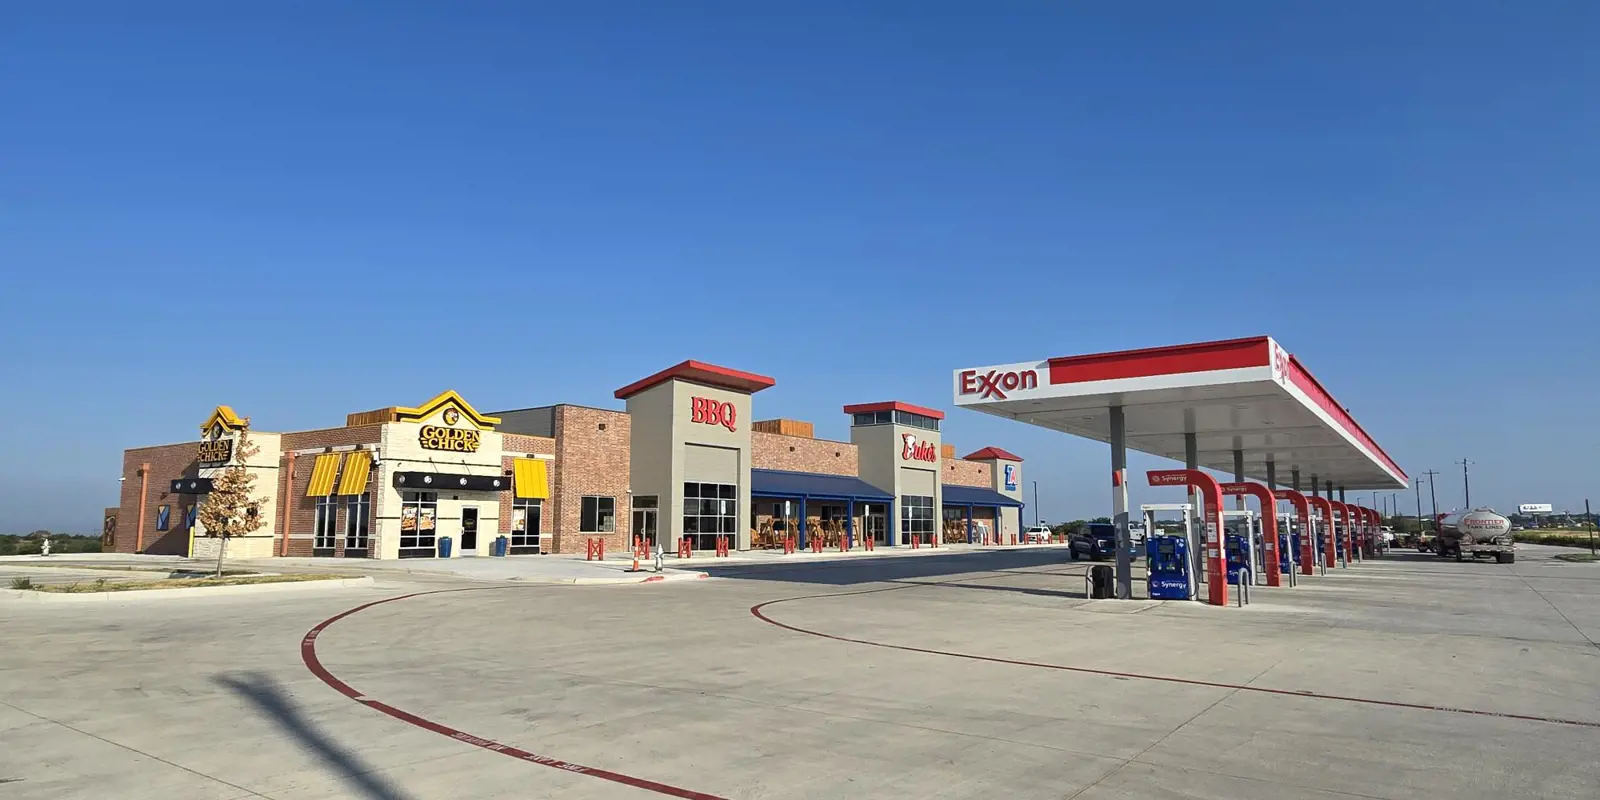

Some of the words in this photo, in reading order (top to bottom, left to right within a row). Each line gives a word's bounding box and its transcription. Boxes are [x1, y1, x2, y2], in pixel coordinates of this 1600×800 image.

[960, 369, 1038, 400] Exxon
[691, 396, 737, 432] BBQ
[422, 425, 480, 441] GOLDEN
[199, 440, 229, 453] GOLDEN
[428, 438, 474, 451] CHICK
[902, 433, 936, 463] Duke's
[200, 450, 224, 462] CHICK
[1161, 581, 1187, 589] Synergy
